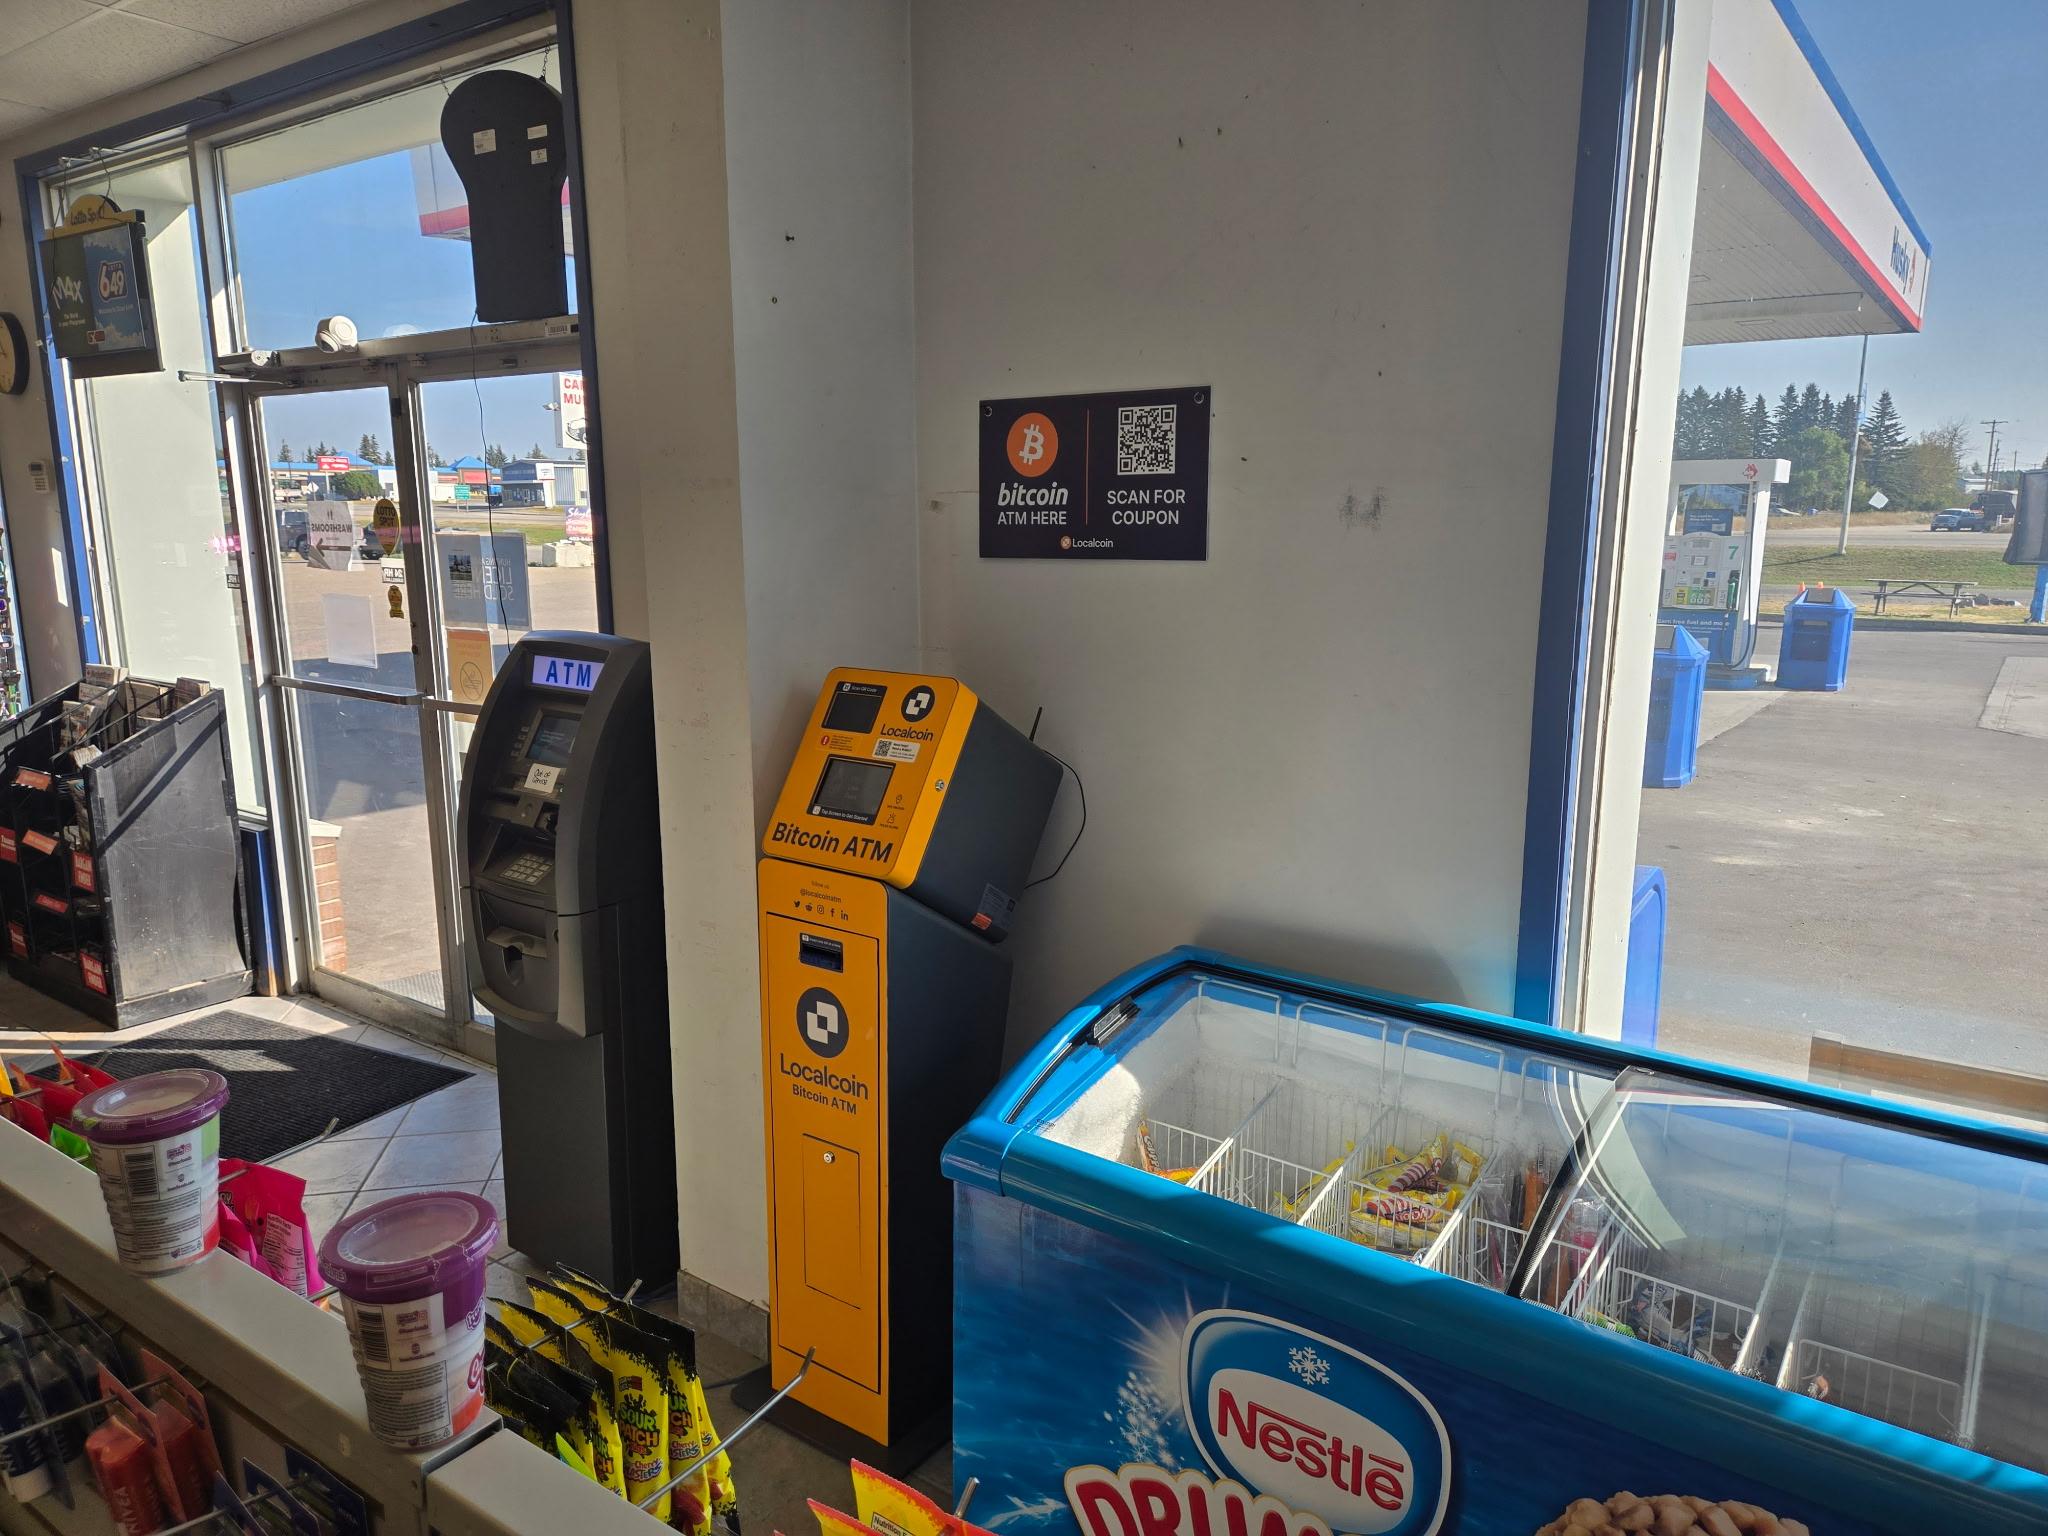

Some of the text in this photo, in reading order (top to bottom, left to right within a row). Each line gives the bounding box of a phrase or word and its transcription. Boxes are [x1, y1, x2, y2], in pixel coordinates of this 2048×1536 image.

[998, 482, 1068, 506] bitcoin
[1107, 489, 1186, 504] SCAN FOR
[998, 511, 1067, 525] ATM HERE
[1112, 510, 1180, 525] COUPON
[1072, 538, 1114, 548] Localcoin
[1728, 545, 1739, 560] 7
[545, 660, 592, 688] ATM
[880, 723, 934, 742] Localcoin
[772, 822, 894, 864] Bitcoin ATM
[780, 1052, 869, 1100] Localcoin
[792, 1084, 857, 1115] Bitcoin ATM
[620, 1407, 657, 1431] SOUR
[620, 1421, 660, 1447] PATCH
[874, 1515, 900, 1536] Nutrition
